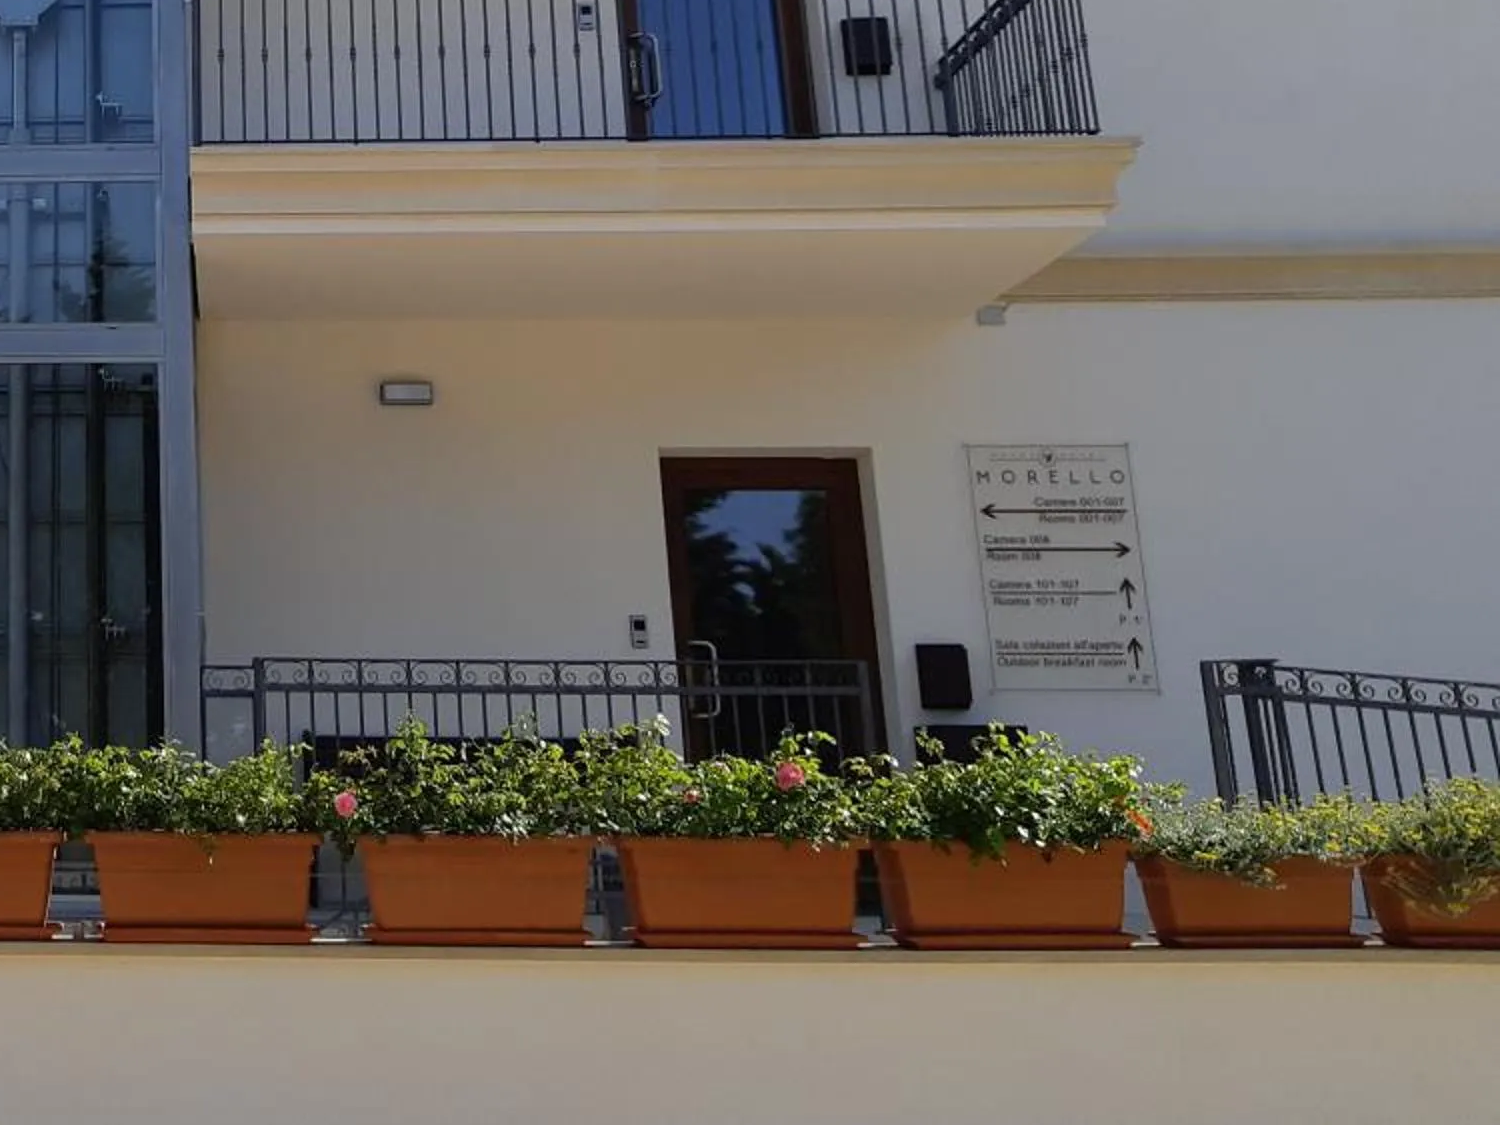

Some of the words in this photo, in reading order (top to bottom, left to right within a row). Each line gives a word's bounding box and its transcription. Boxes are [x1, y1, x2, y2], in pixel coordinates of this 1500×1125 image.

[975, 469, 1126, 485] MORELLO
[986, 552, 1018, 561] Room
[996, 657, 1040, 667] Outdoor
[1043, 657, 1095, 667] breakfast
[1098, 658, 1127, 667] room
